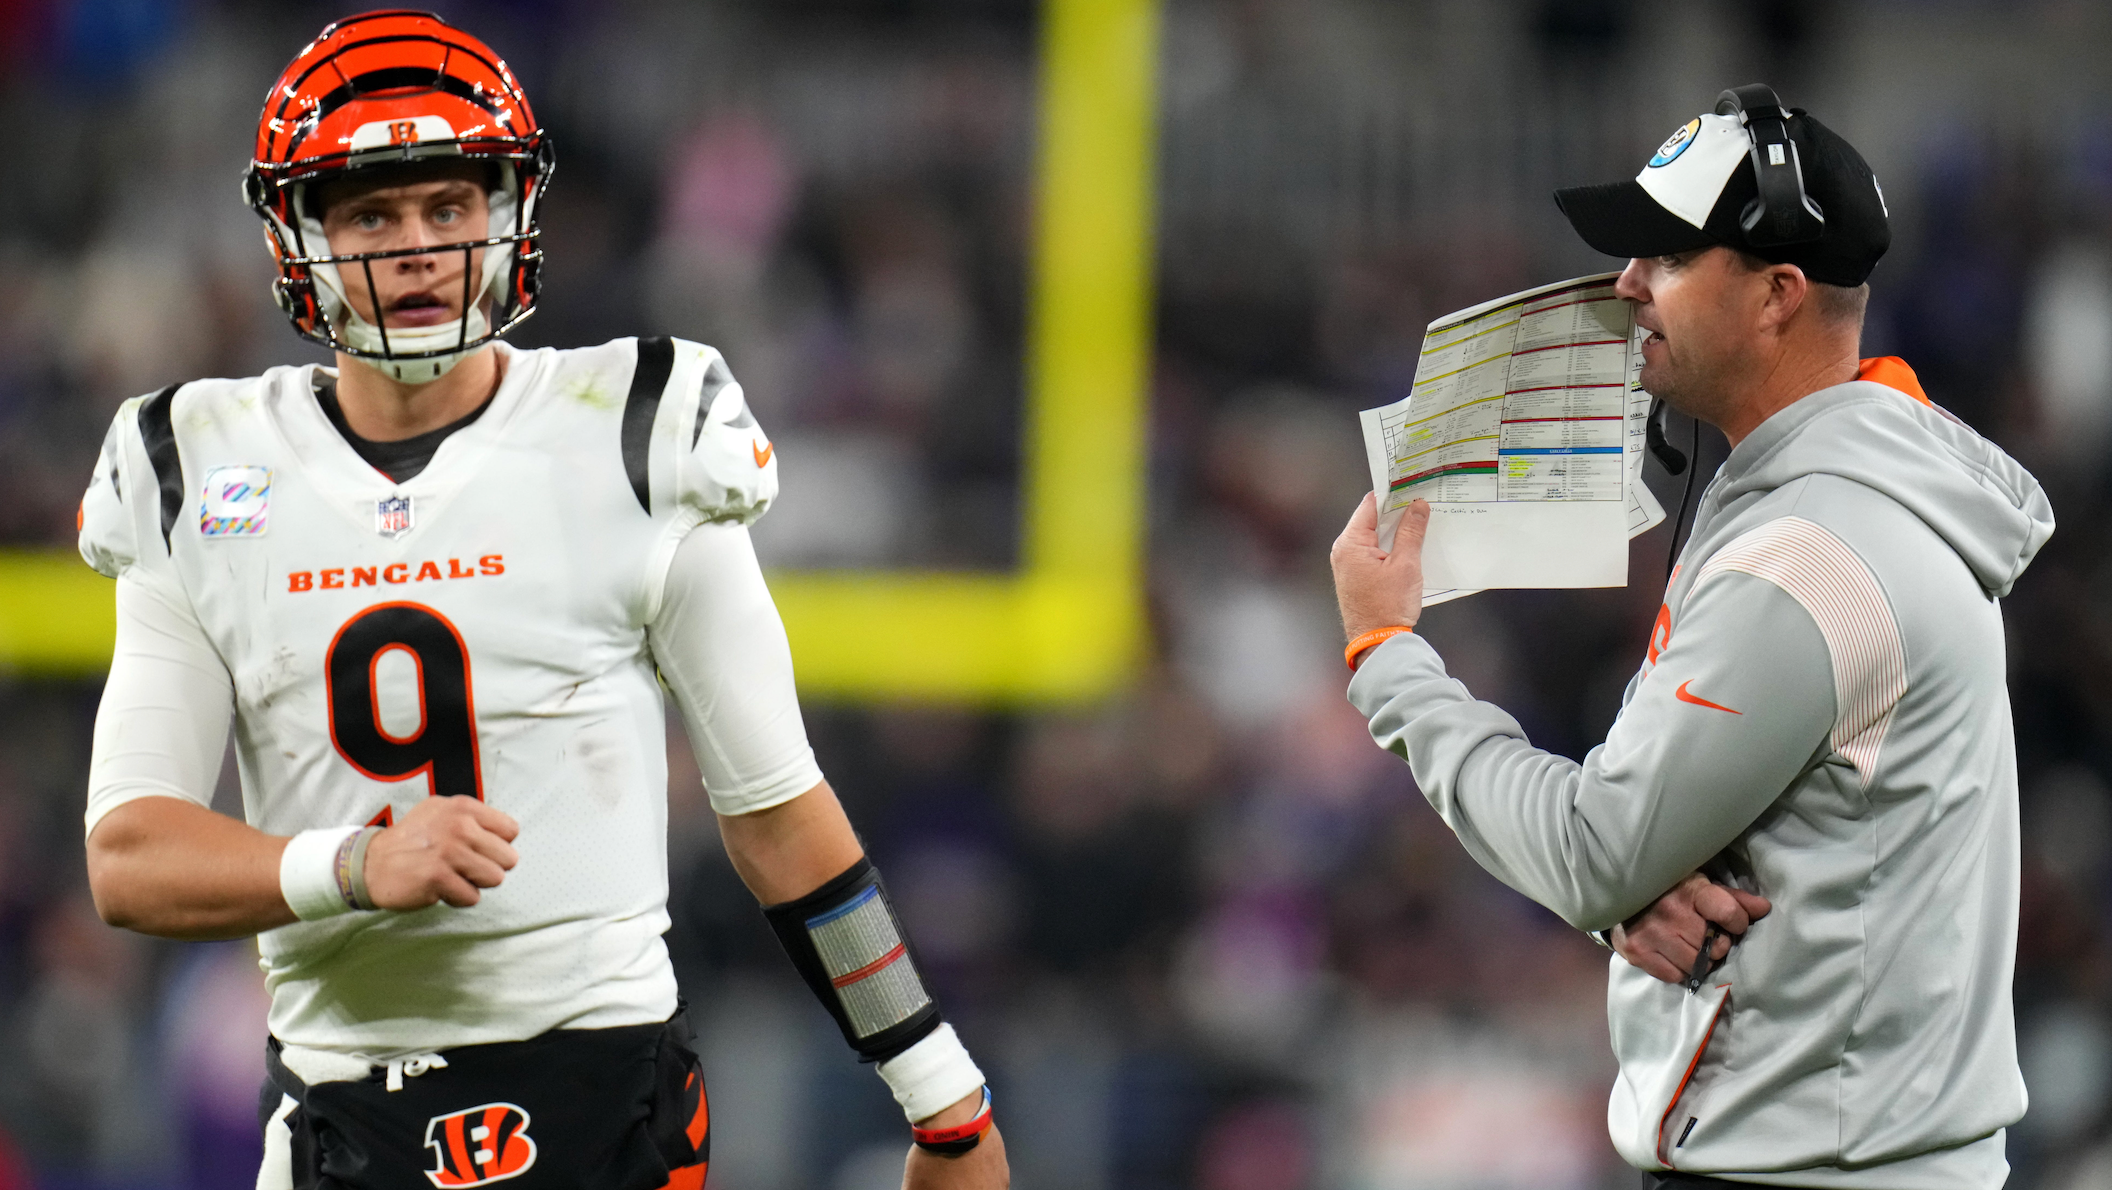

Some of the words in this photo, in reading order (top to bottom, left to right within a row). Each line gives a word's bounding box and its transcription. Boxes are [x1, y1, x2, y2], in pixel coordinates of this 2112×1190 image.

[288, 554, 505, 593] BENGALS
[1352, 635, 1375, 650] PUTTING
[1375, 630, 1396, 639] FAITH
[325, 600, 485, 828] 9
[934, 1130, 959, 1140] MIND
